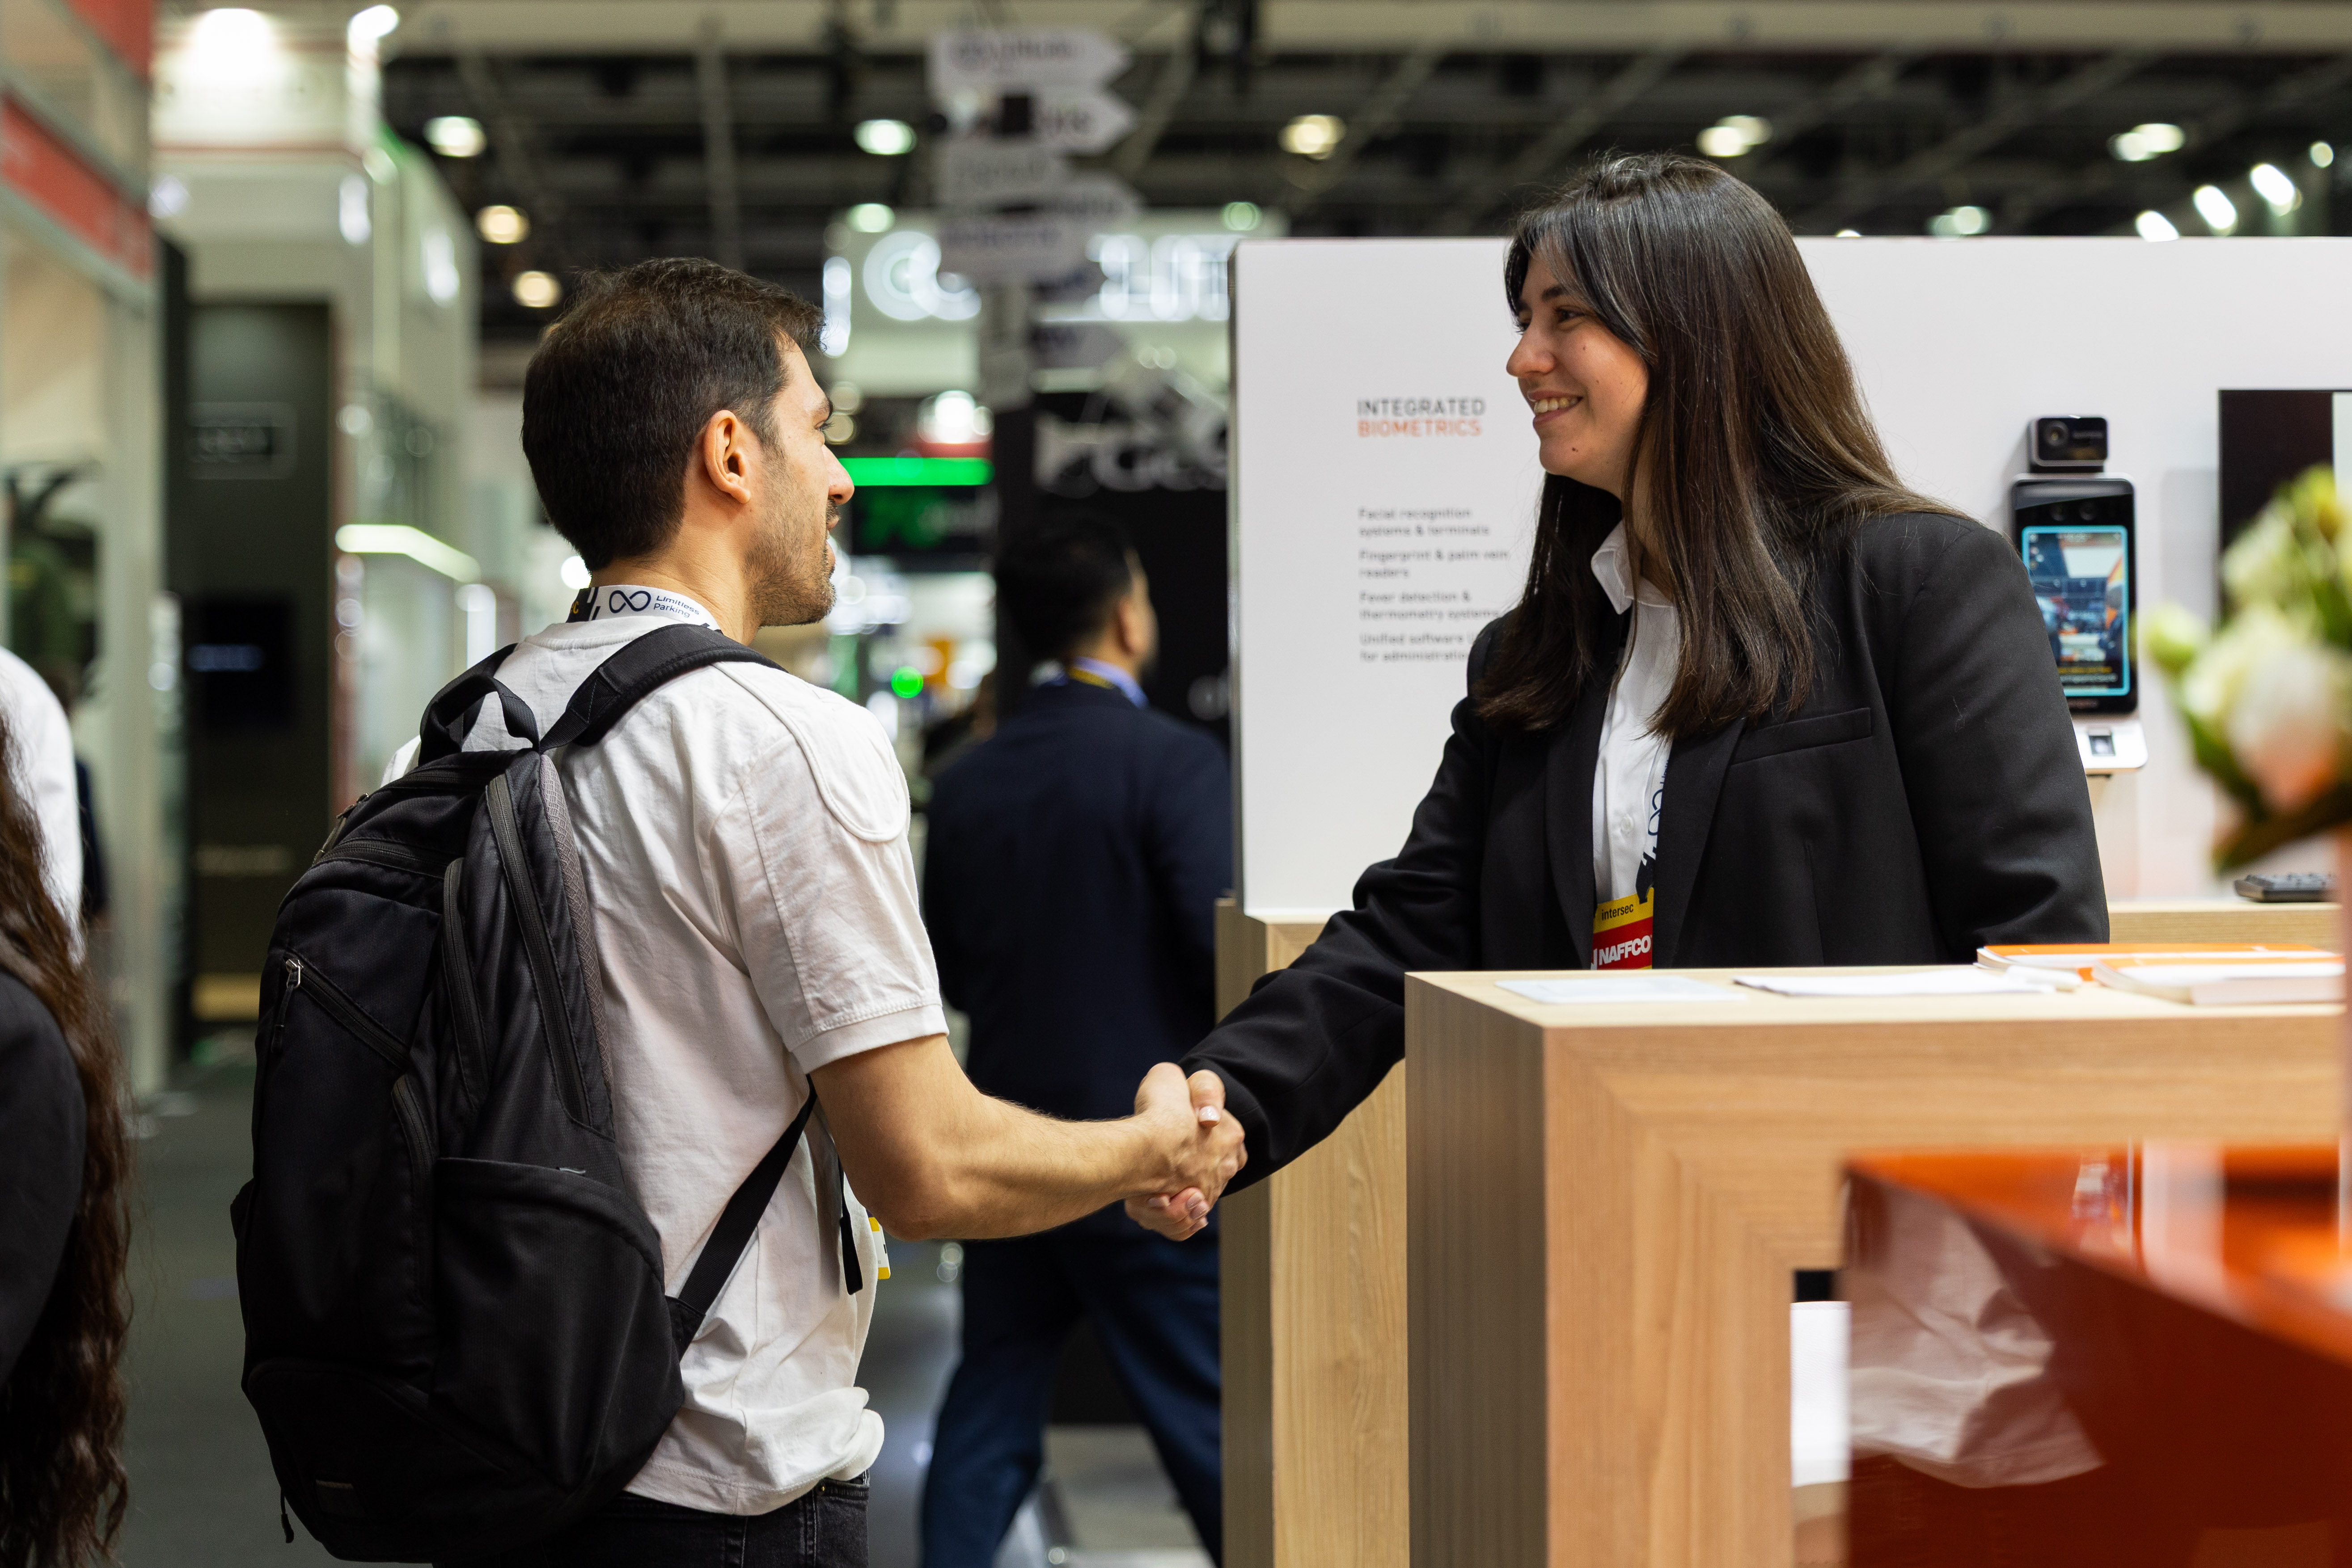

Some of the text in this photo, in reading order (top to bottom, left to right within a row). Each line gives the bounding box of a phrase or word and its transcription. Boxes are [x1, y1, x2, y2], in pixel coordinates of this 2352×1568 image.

[1358, 397, 1485, 416] INTEGRATED
[1358, 419, 1481, 437] BIOMETRICS
[1358, 508, 1471, 522] Facial recognition
[1358, 524, 1489, 540] systems & terminals
[1358, 549, 1509, 565] Fingerprint & palm vein
[1358, 566, 1409, 579] readers
[1400, 591, 1457, 604] detection
[1461, 590, 1471, 602] &
[654, 603, 690, 618] Parking
[656, 596, 699, 615] Limitless
[1359, 608, 1444, 623] thermometry
[1359, 633, 1405, 646] Unified
[1409, 633, 1464, 644] software
[1360, 650, 1468, 663] for administratio
[1601, 904, 1633, 921] intersec
[1599, 935, 1651, 966] NAFFCO
